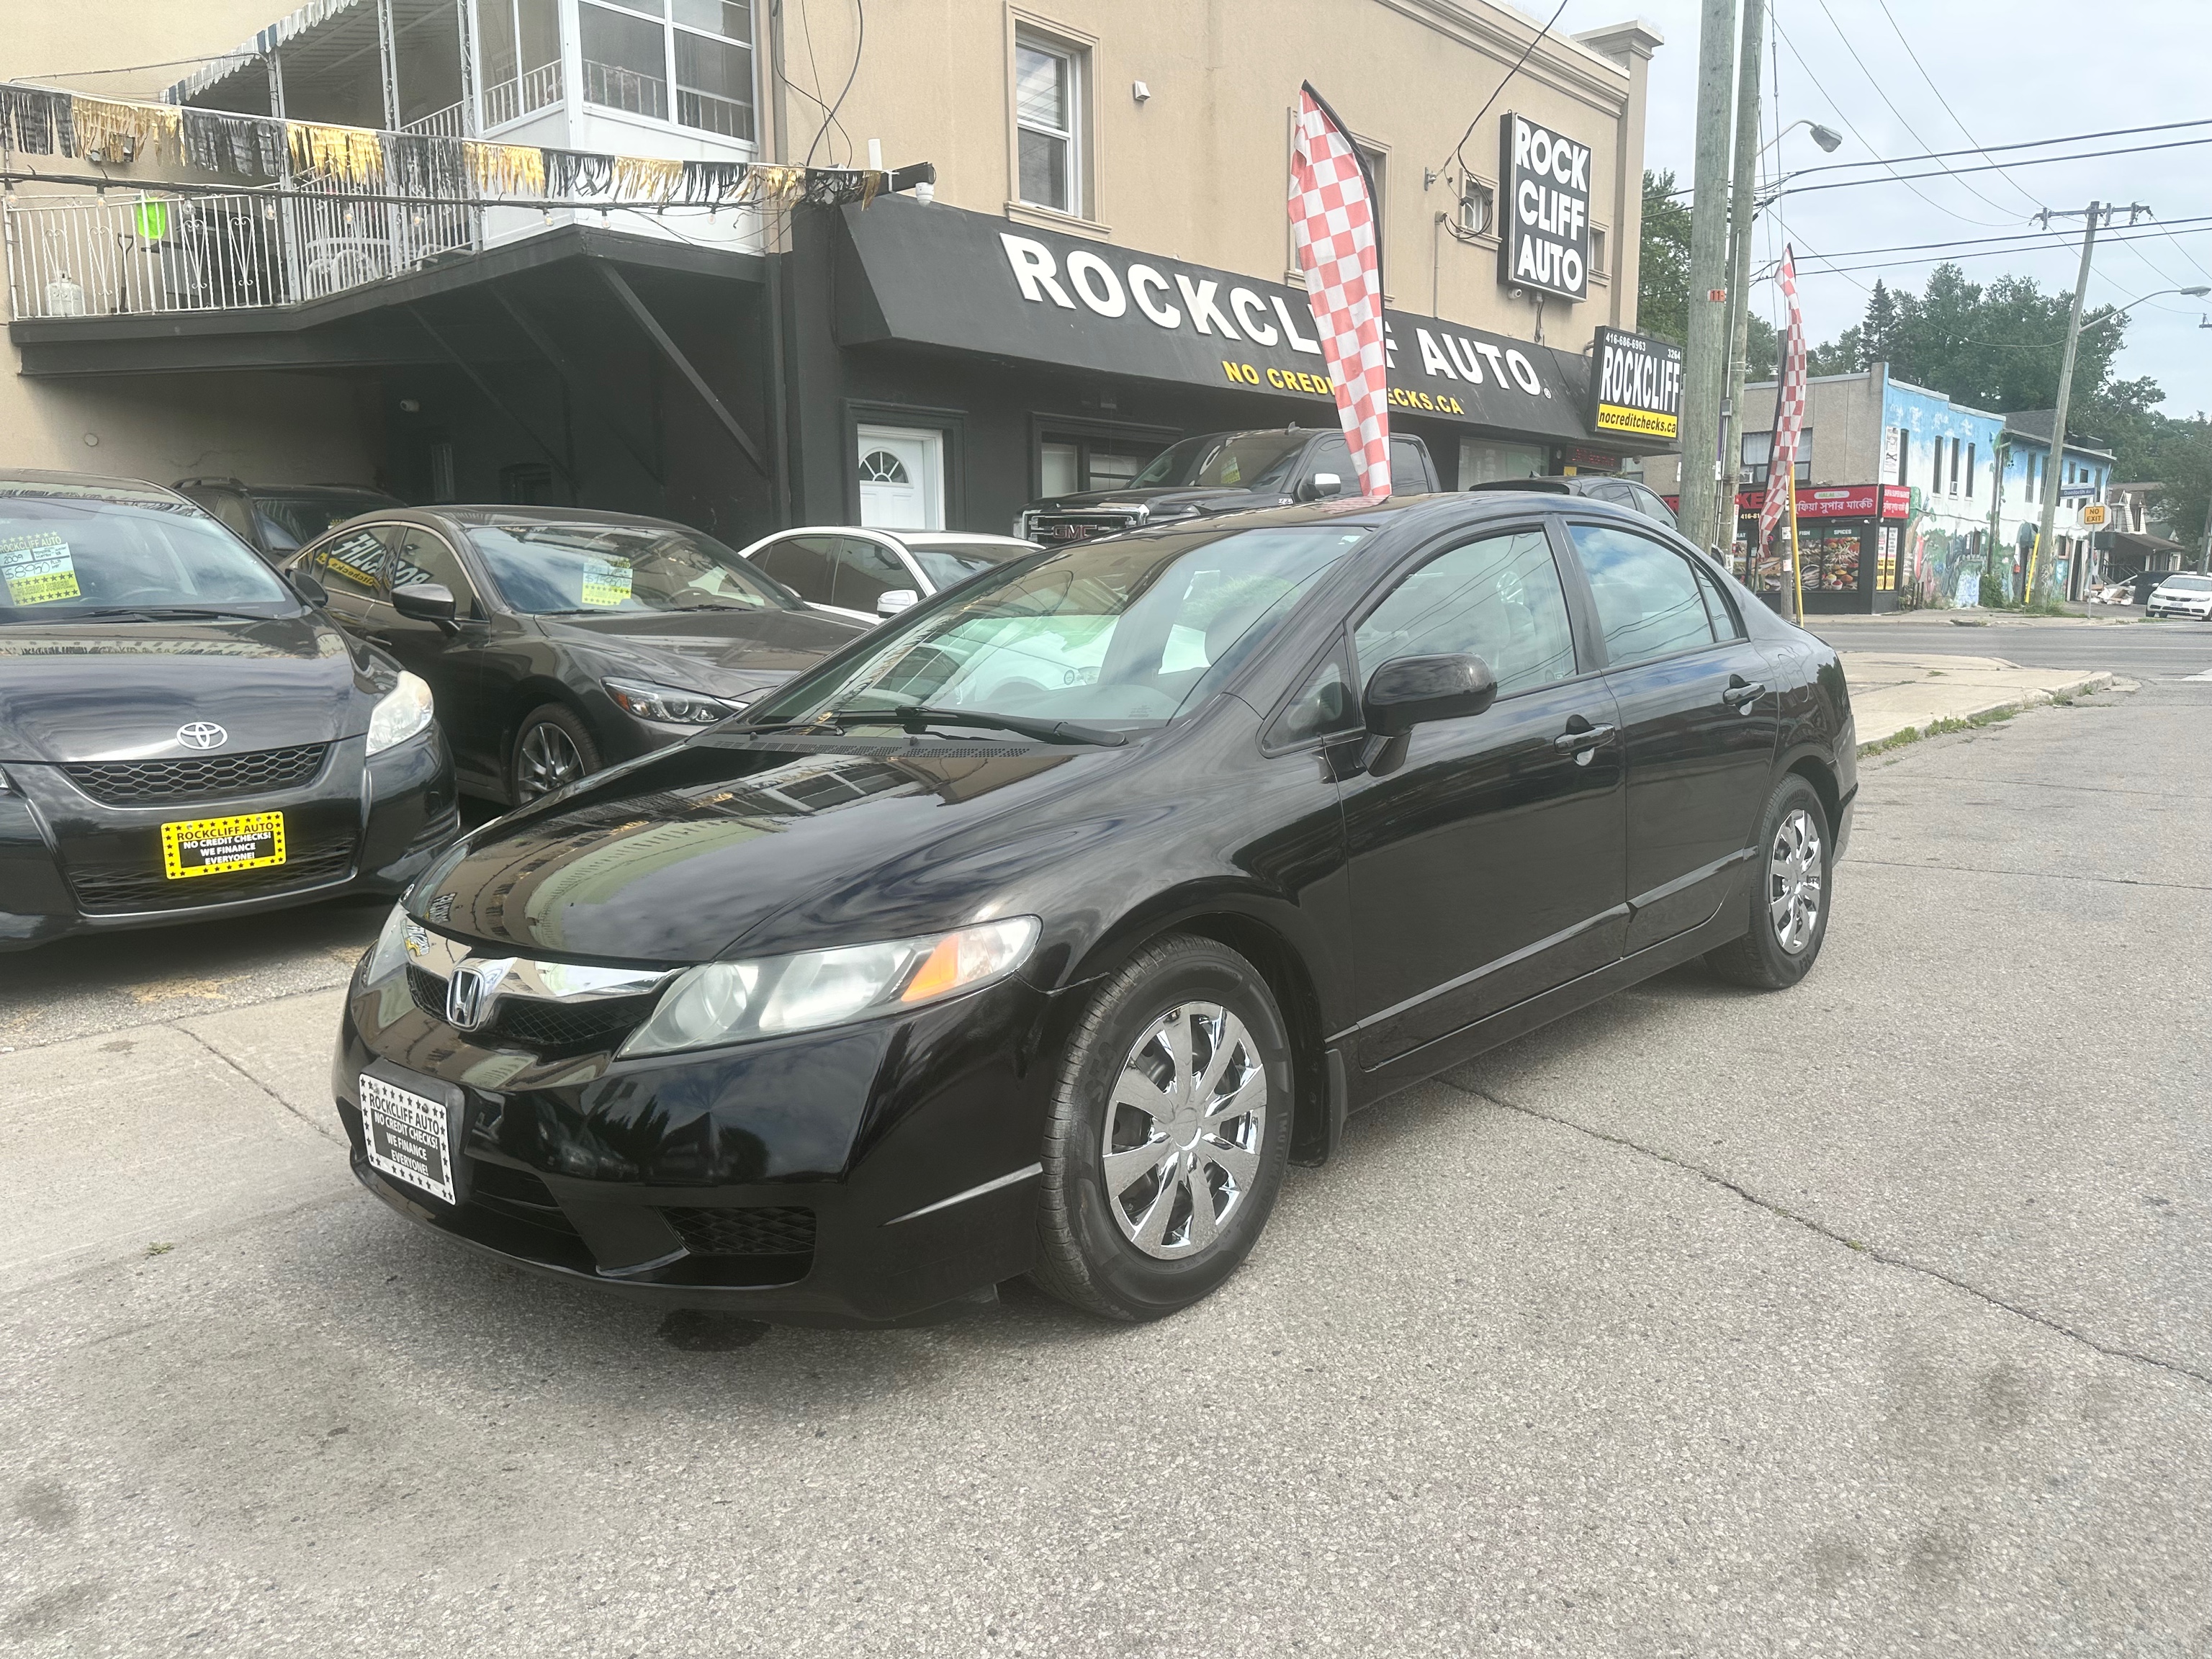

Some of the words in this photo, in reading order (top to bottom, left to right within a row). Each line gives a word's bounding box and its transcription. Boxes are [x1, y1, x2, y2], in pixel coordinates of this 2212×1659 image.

[1516, 120, 1588, 192] ROCK
[1519, 179, 1584, 240] CLIFF
[1517, 234, 1583, 292] AUTO
[999, 232, 1398, 369] ROCKCL
[1416, 328, 1541, 396] AUTO
[1606, 333, 1646, 351] 416-686-6963
[1667, 349, 1681, 360] 3264
[1223, 361, 1260, 385] NO
[1267, 369, 1335, 396] CREDI
[1387, 387, 1465, 415] ECKS.CA
[1600, 345, 1681, 413] ROCKCLIFF
[1599, 411, 1676, 433] nocreditchecks.ca
[0, 539, 40, 554] ROCKCLIFF
[41, 536, 62, 546] AUTO
[1053, 525, 1097, 539] GMC
[4, 554, 24, 565] 2009
[5, 562, 50, 580] $8950
[177, 827, 240, 841] ROCKCLIFF
[244, 822, 274, 834] AUTO
[184, 841, 199, 850] NO
[199, 837, 233, 848] CREDIT
[234, 832, 271, 843] CHECKS!
[200, 848, 216, 857] WE
[217, 842, 256, 855] FINANCE
[204, 852, 255, 866] EVERYONE!
[369, 1093, 413, 1125] ROCKCLIFF
[415, 1112, 439, 1136] AUTO
[374, 1112, 385, 1125] NO
[385, 1116, 408, 1136] CREDIT
[409, 1128, 439, 1150] CHECKS!
[386, 1132, 397, 1146] WE
[397, 1136, 428, 1161] FINANCE
[391, 1149, 429, 1177] EVERYONE!
